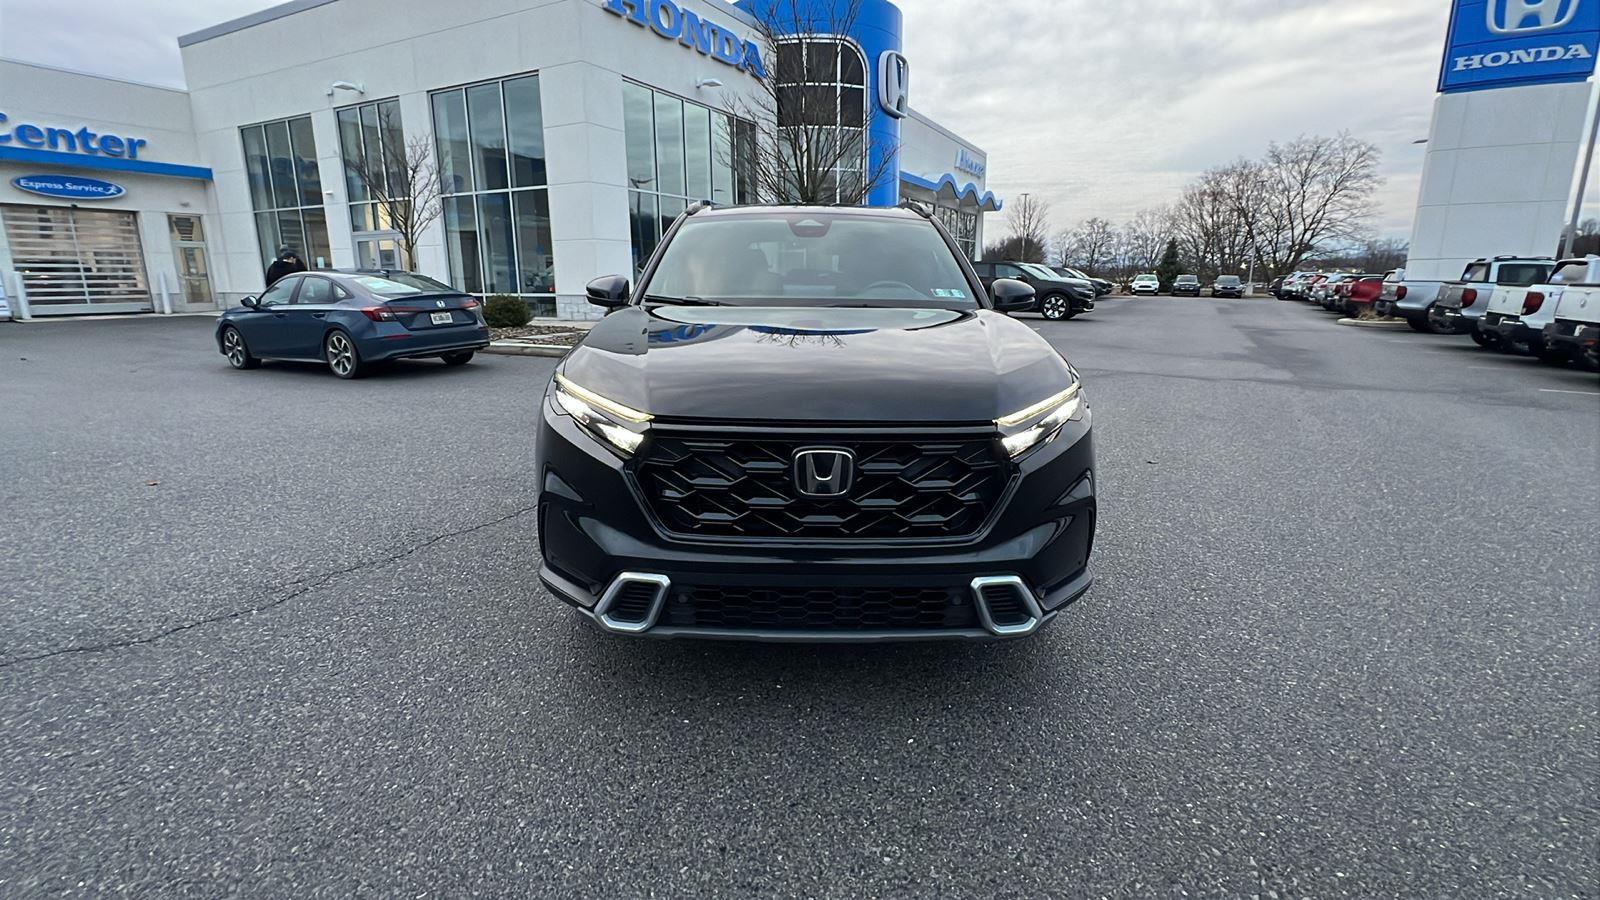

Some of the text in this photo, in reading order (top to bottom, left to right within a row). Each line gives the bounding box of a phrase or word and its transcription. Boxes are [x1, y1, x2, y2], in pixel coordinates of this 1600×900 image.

[1452, 44, 1592, 71] HONDA
[20, 179, 104, 193] Express Service
